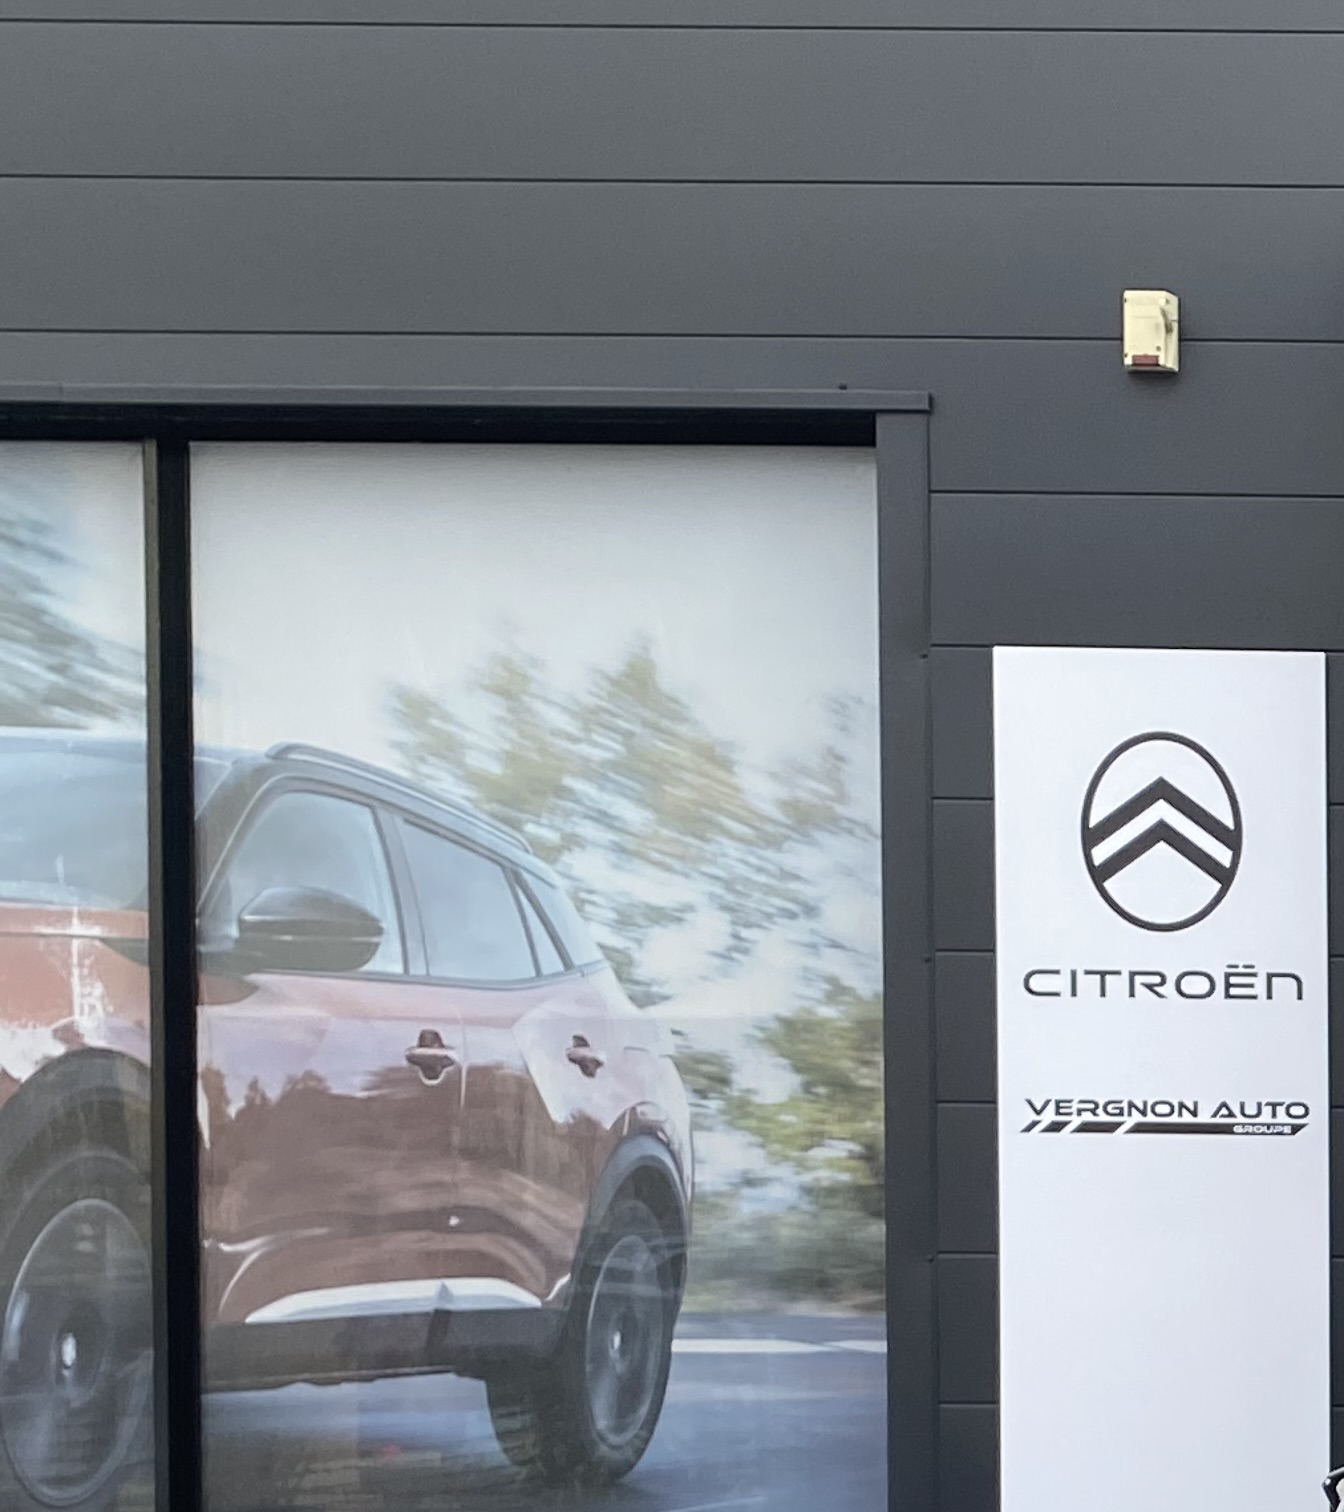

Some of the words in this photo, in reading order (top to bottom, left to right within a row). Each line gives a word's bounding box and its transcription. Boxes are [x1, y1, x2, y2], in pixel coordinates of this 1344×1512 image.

[1025, 1098, 1199, 1119] VERGNON
[1210, 1100, 1310, 1120] AUTO
[1232, 1124, 1293, 1134] GROUPE
